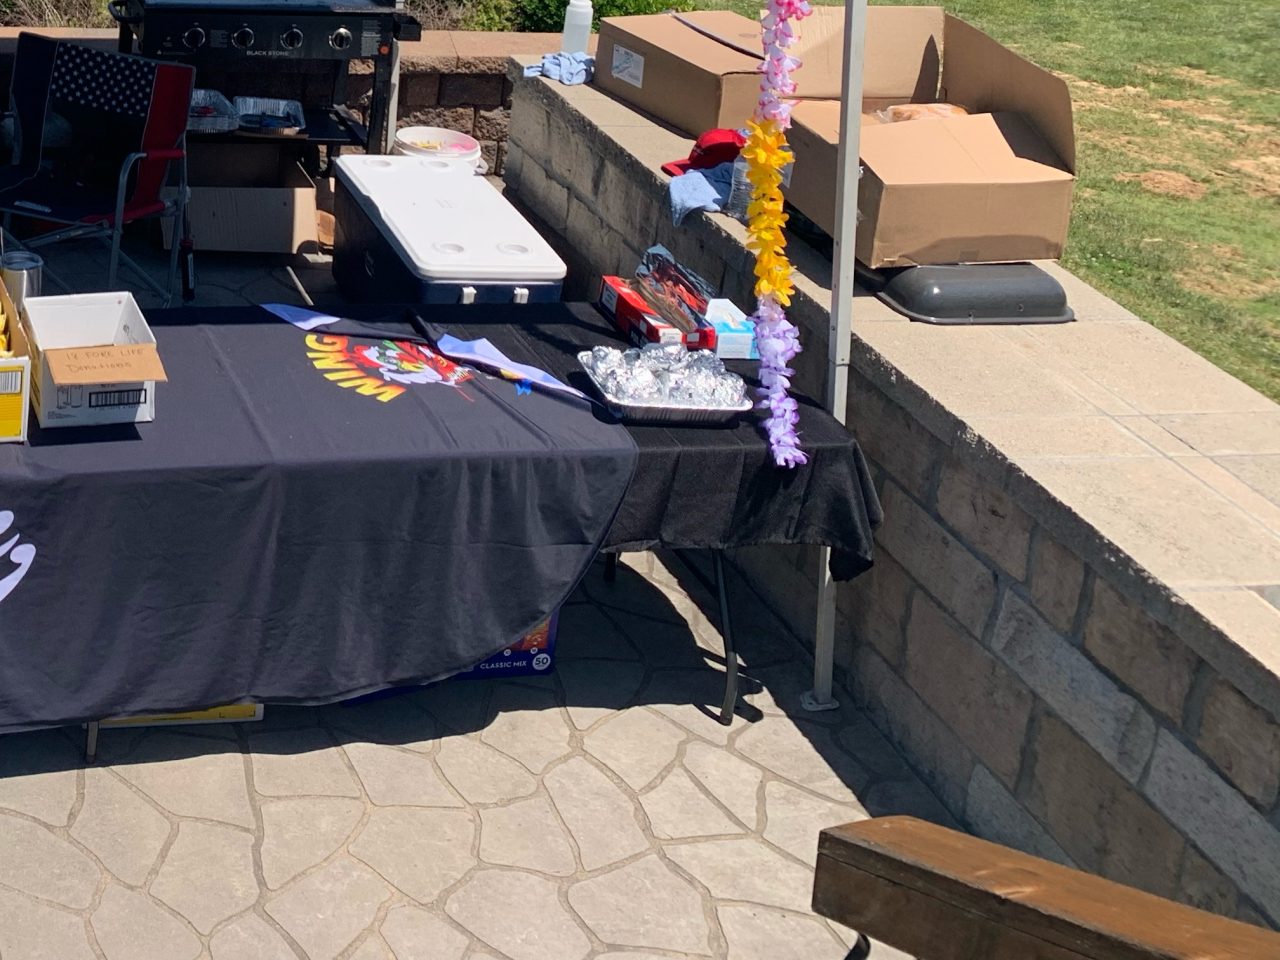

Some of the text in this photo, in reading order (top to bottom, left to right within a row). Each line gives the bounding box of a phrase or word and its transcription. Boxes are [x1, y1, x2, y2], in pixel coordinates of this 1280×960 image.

[85, 350, 114, 360] FORE
[120, 348, 144, 357] LIFE
[480, 661, 512, 670] CLASSIC
[535, 657, 549, 666] 50
